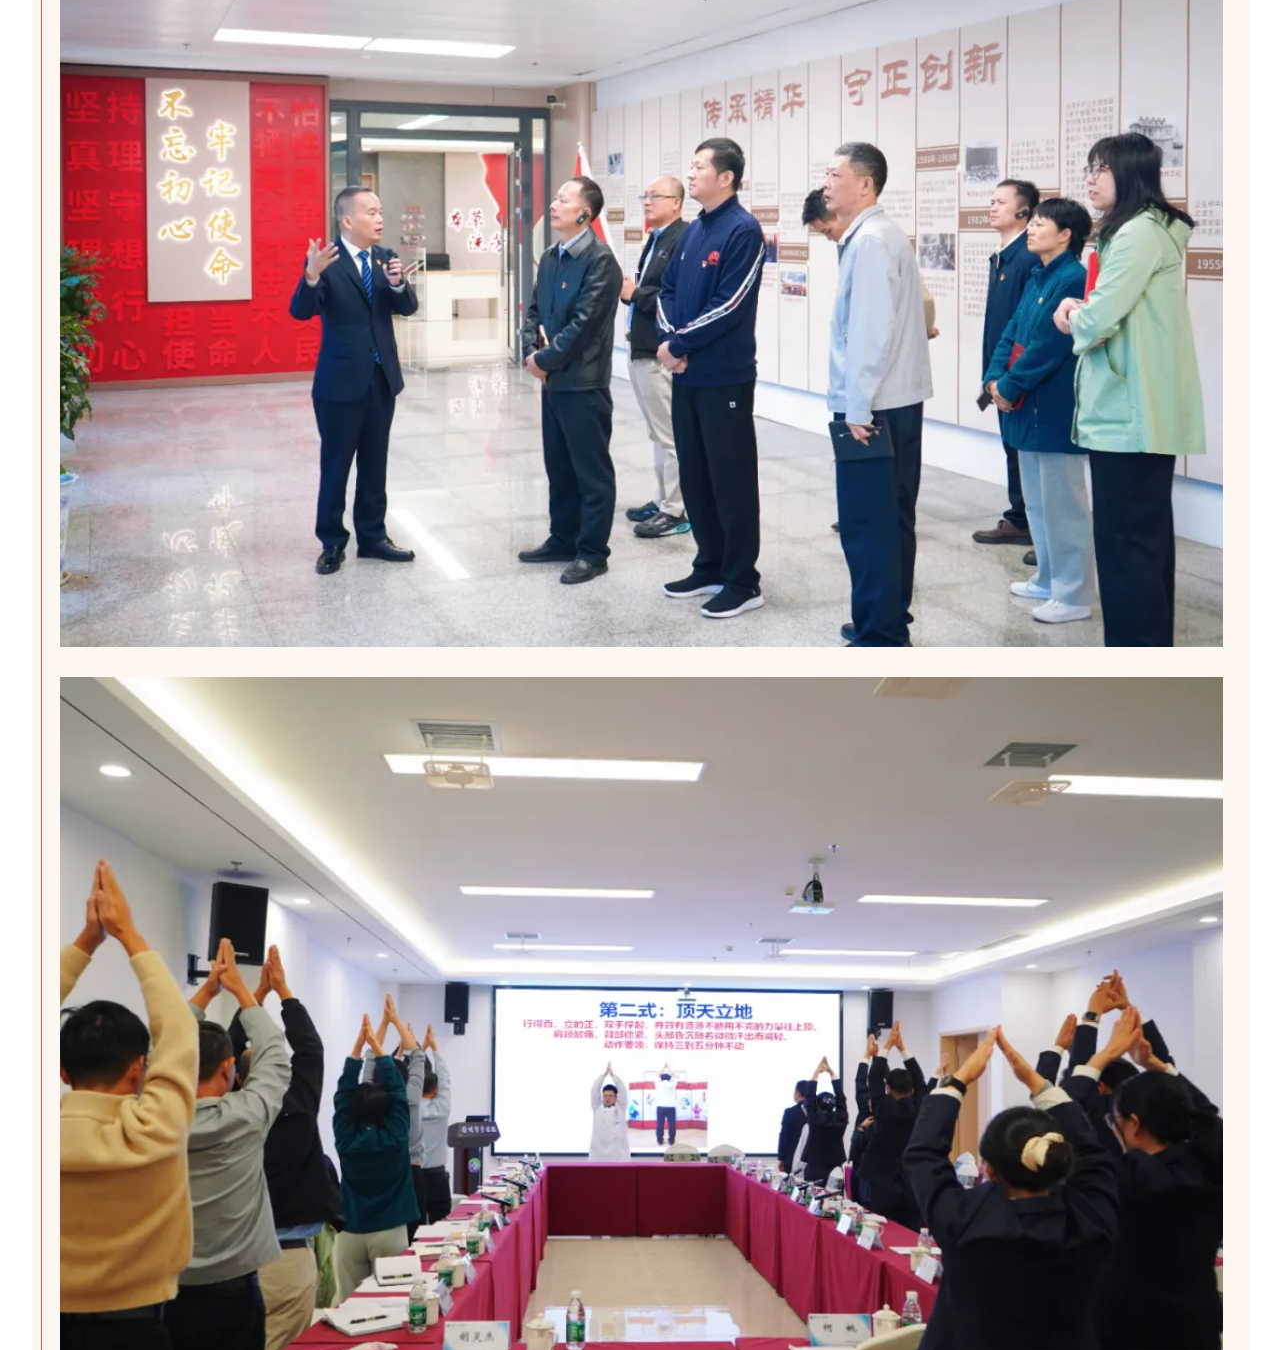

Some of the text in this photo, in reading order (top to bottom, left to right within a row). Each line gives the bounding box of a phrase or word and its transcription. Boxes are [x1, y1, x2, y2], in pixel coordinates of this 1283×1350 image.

[844, 42, 1003, 106] 守正创新
[703, 82, 806, 129] 传承精华
[157, 88, 197, 240] 不忘初心
[201, 120, 242, 284] 牢记使命
[1197, 258, 1223, 270] 1955
[599, 1002, 753, 1019] 第二式：顶天立地
